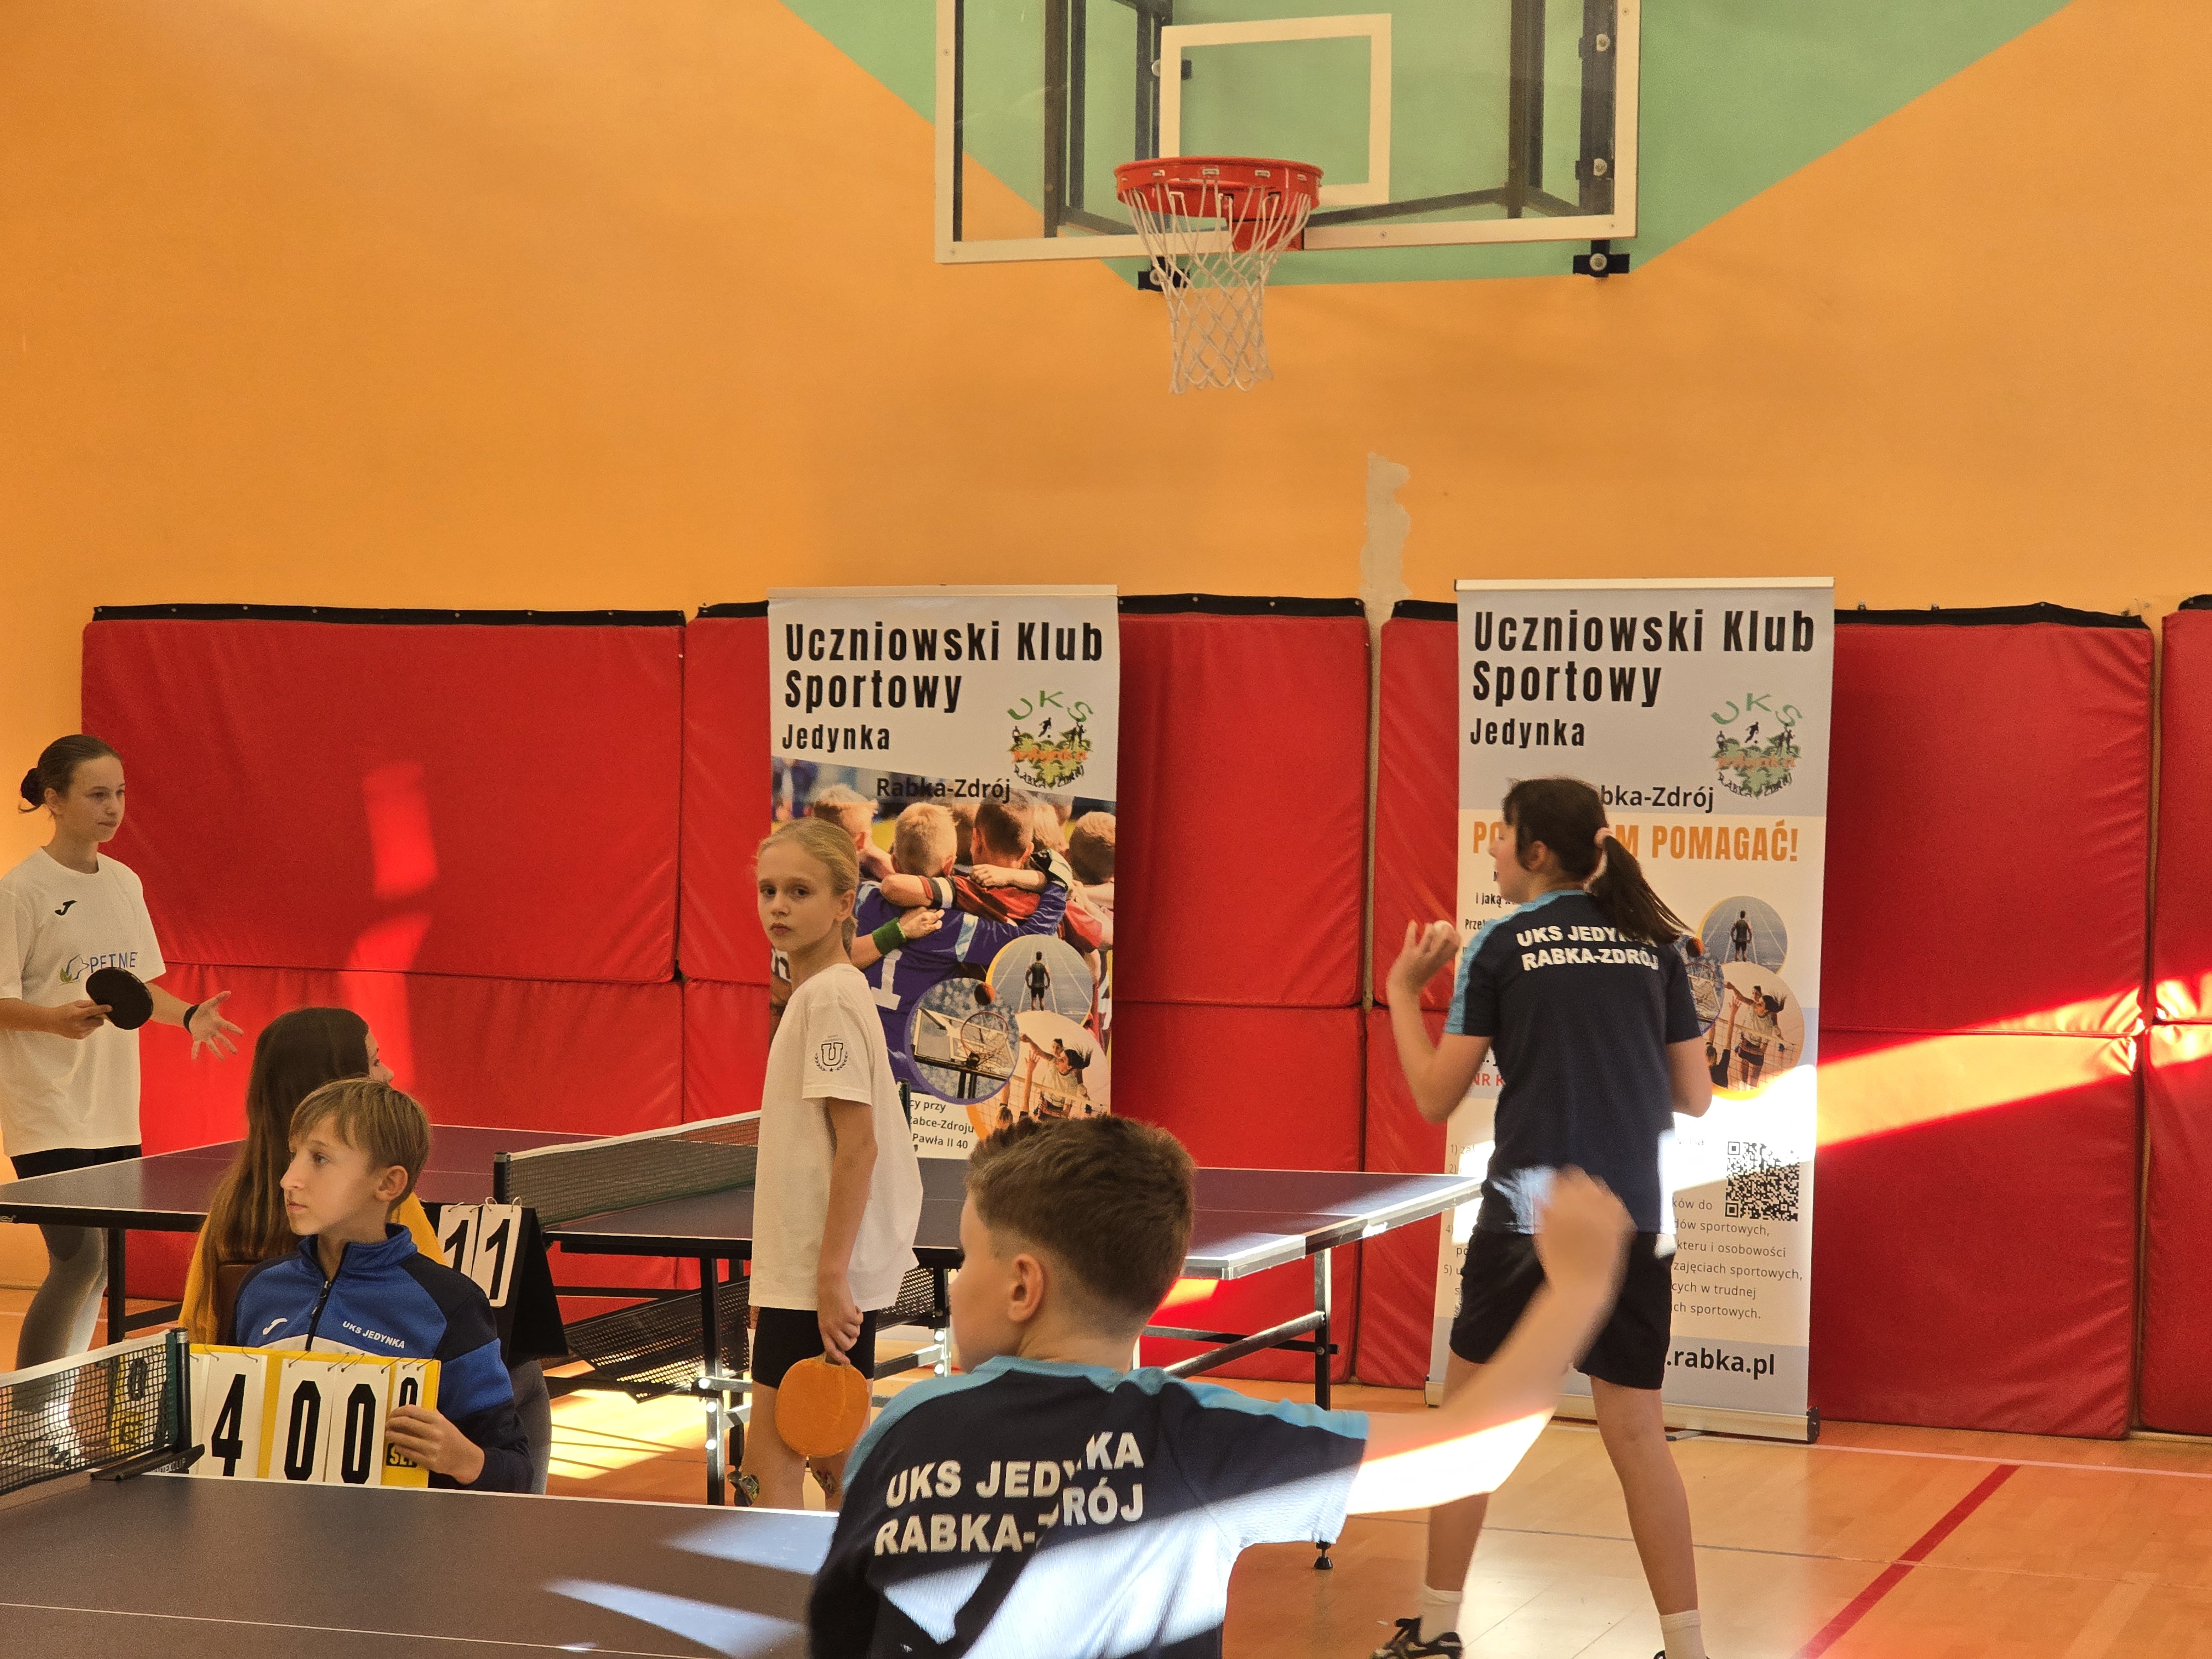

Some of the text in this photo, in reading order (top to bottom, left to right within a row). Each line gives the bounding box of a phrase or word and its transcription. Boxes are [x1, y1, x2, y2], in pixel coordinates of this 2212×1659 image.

[785, 620, 1102, 661] Uczniowski Klub
[1474, 609, 1814, 653] Uczniowski Klub
[785, 669, 962, 713] Sportowy
[1473, 661, 1661, 707] Sportowy
[1007, 690, 1093, 722] UKS
[1711, 693, 1803, 727] UKS
[781, 724, 890, 753] Jedynka
[1470, 718, 1585, 748] Jedynka
[877, 778, 1010, 804] Rabka-Zdrój
[1601, 785, 1713, 813] bka-Zdrój
[1652, 820, 1798, 862] POMAGAĆ!
[1481, 893, 1501, 908] jaką
[1516, 926, 1563, 947] UKS
[1521, 947, 1658, 971] RABKA-ZDRÓJ
[821, 1042, 843, 1066] U
[924, 1102, 946, 1113] przy
[910, 1116, 974, 1134] abce-Zdroju
[912, 1133, 943, 1145] Pawła
[956, 1140, 968, 1149] 40
[1672, 1198, 1713, 1210] ków do
[1700, 1222, 1770, 1237] sportowych,
[1718, 1244, 1786, 1258] osobowości
[1673, 1262, 1802, 1281] zajęciach sportowych,
[1700, 1285, 1710, 1293] w
[1714, 1285, 1756, 1300] trudnej
[1691, 1305, 1761, 1319] sportowych.
[342, 1321, 405, 1349] UKS JEDYNKA
[211, 1374, 246, 1477] 4
[885, 1459, 961, 1509] UKS
